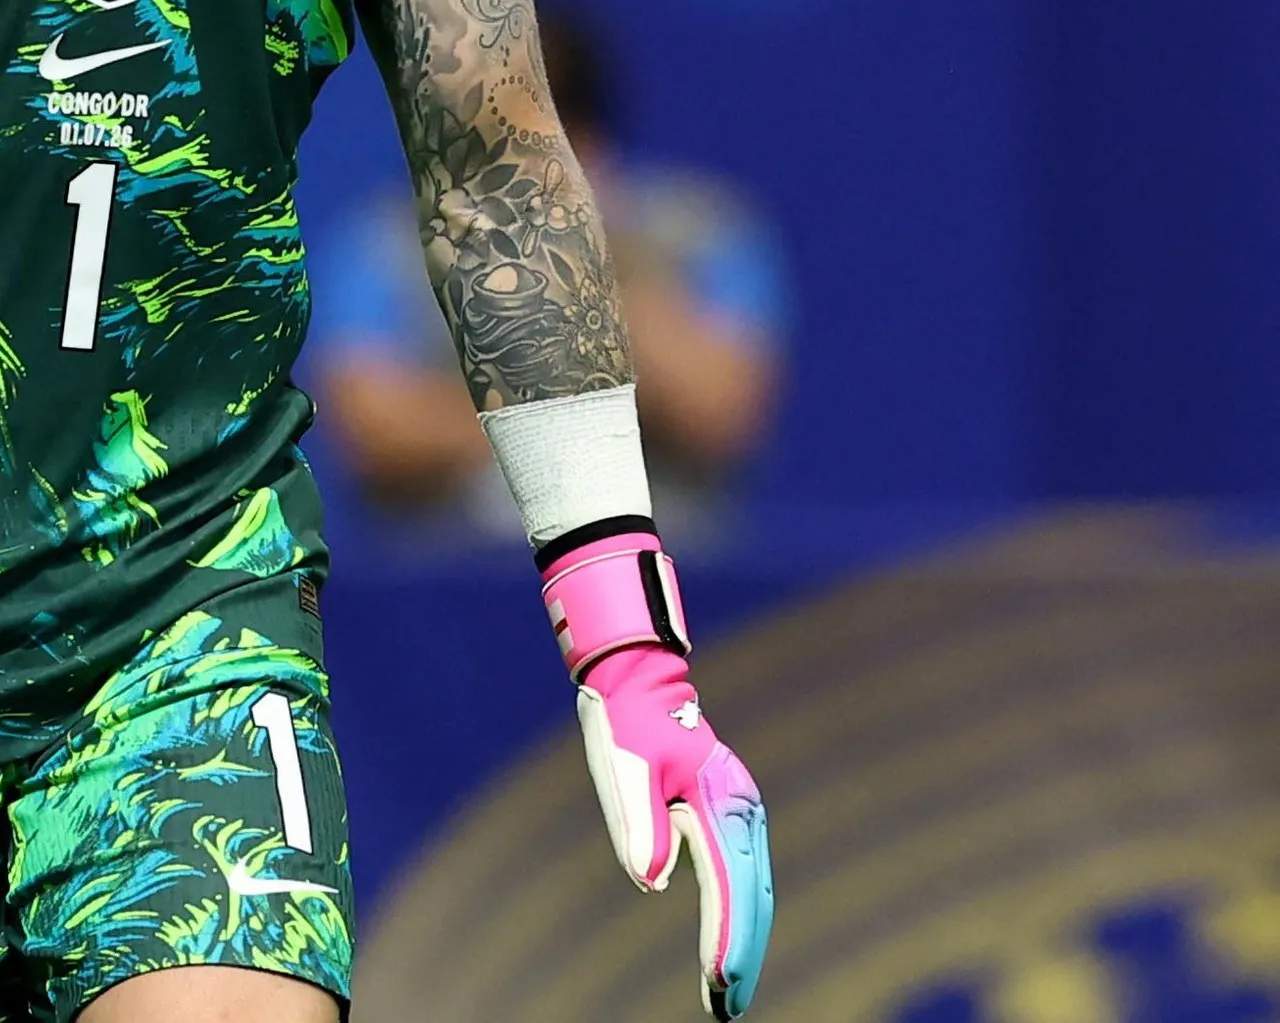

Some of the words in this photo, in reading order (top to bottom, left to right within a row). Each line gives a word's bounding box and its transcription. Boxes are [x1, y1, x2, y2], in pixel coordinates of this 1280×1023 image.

[47, 91, 118, 116] CONGO
[120, 92, 150, 118] DR
[60, 121, 134, 149] 01.07.26
[61, 162, 117, 351] 1
[251, 691, 314, 855] 1
